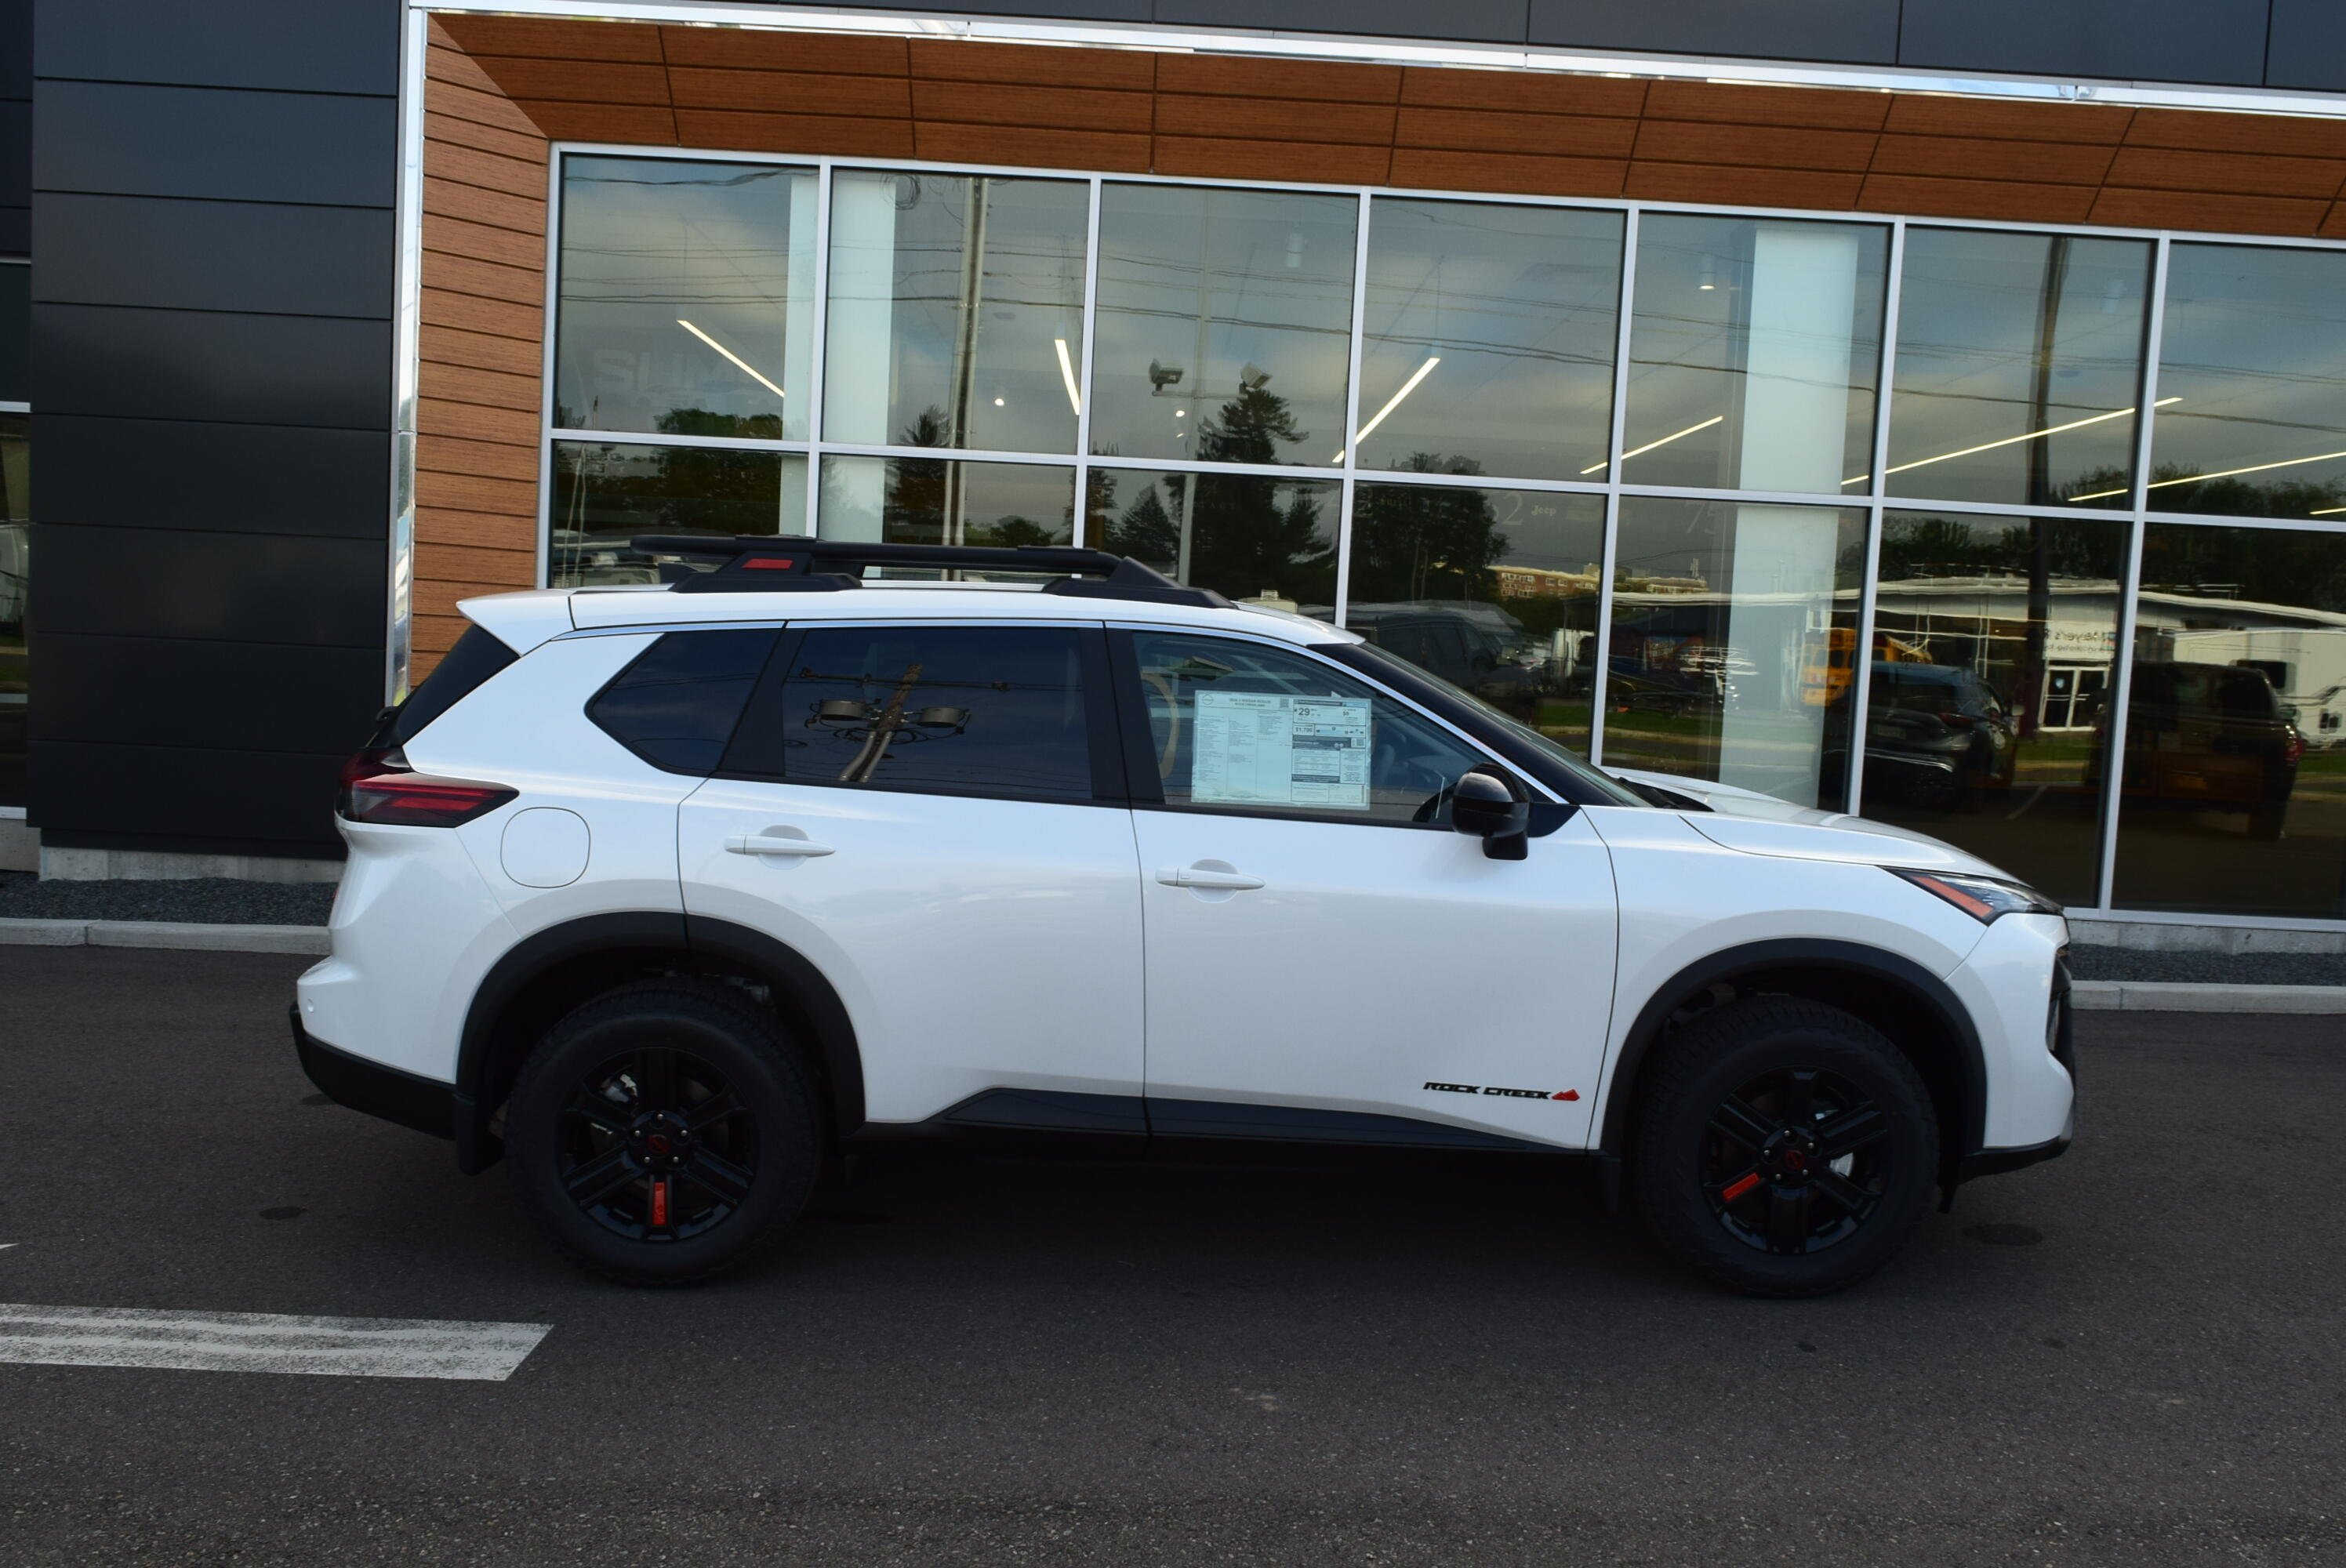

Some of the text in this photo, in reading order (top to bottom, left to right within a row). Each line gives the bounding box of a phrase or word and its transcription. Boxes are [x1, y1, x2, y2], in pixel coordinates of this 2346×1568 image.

[1531, 504, 1556, 517] Jeep
[1298, 707, 1310, 716] 29
[1423, 1082, 1552, 1099] ROCK CREEK
